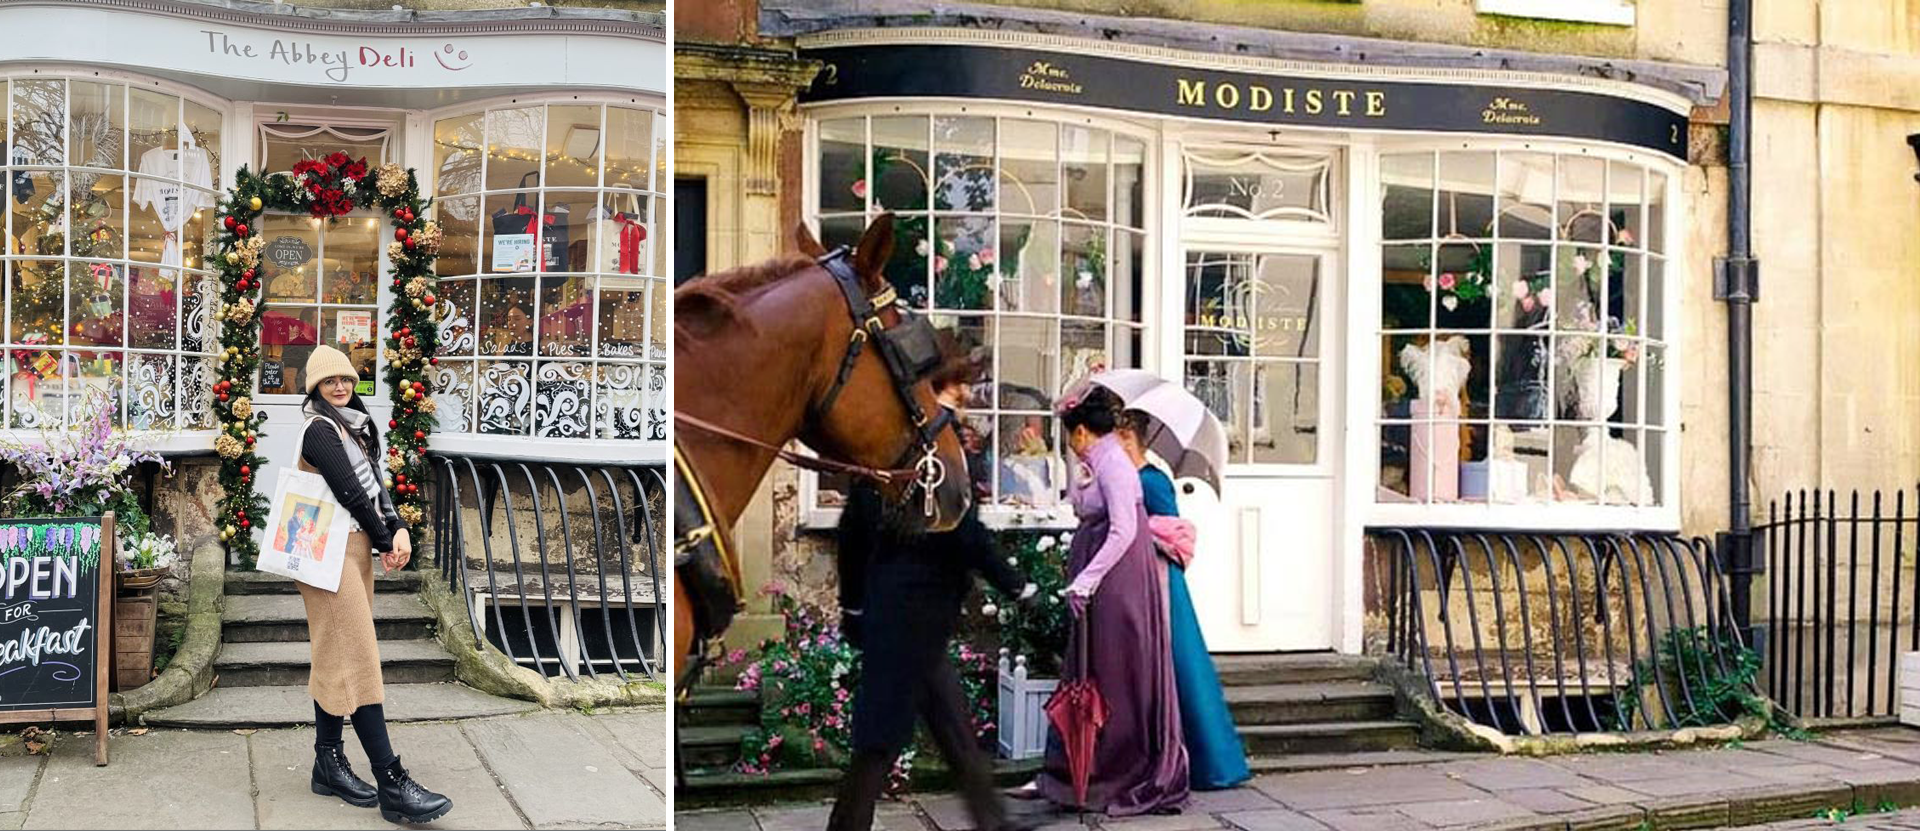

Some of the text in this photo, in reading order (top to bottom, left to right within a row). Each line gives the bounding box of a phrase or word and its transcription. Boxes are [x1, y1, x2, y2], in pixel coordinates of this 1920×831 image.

[200, 30, 414, 82] The Abbey Deli
[825, 63, 838, 85] 2
[1176, 79, 1386, 116] MODISTE
[1670, 123, 1678, 144] 2
[1272, 179, 1284, 198] 2
[275, 249, 302, 260] OPEN
[1200, 314, 1306, 332] MODISTE
[482, 341, 526, 354] Salads
[547, 341, 574, 356] Pies
[602, 341, 634, 356] Bakes
[5, 603, 32, 621] FOR
